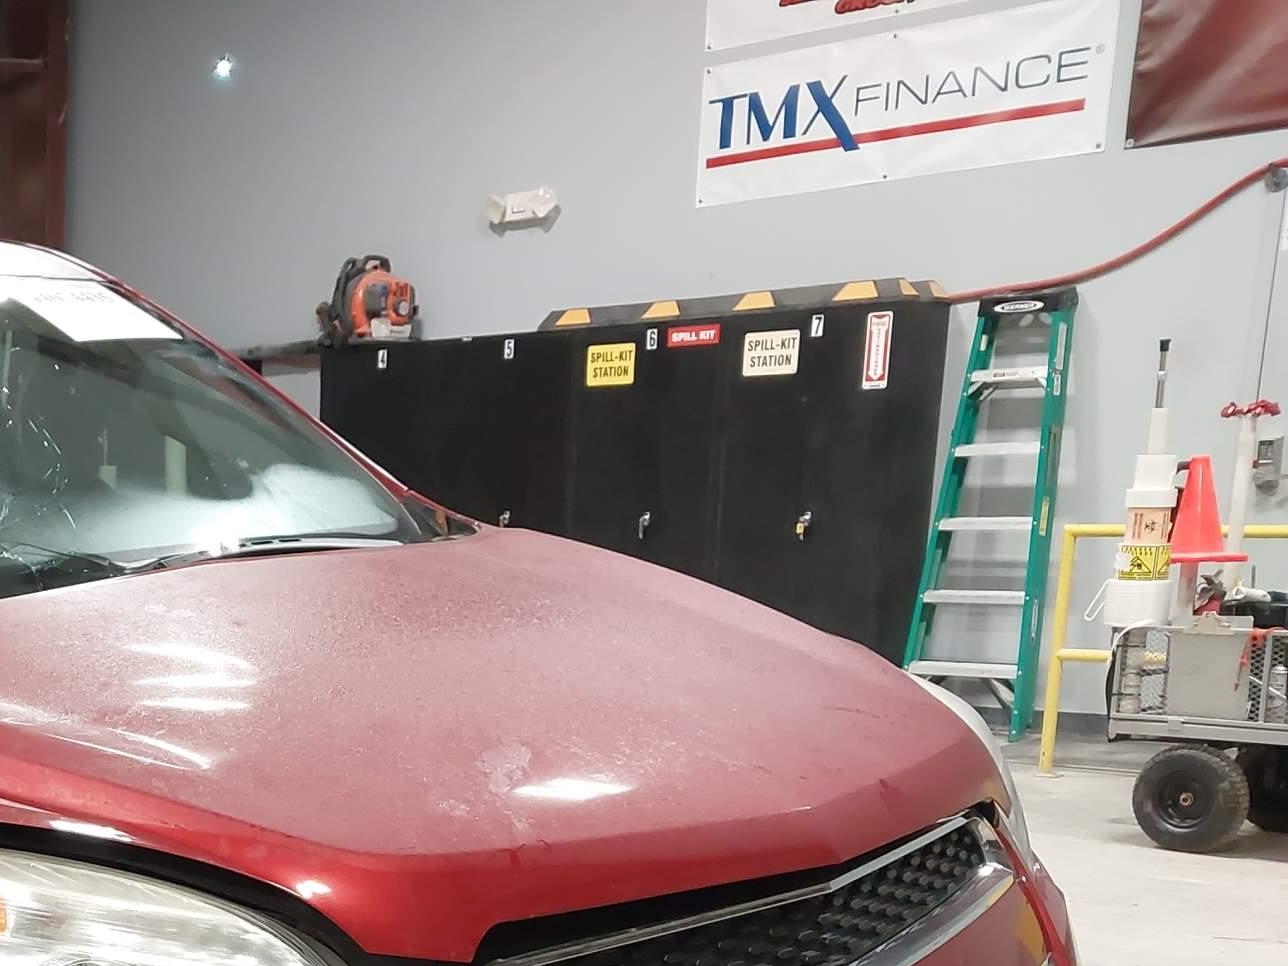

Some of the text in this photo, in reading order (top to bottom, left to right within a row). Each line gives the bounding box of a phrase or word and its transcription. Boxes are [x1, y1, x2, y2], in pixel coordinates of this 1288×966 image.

[708, 46, 1091, 152] TMX FINANCE
[813, 316, 823, 335] 7
[648, 330, 657, 348] 6
[671, 329, 717, 342] SPILL KIT
[505, 340, 513, 358] 5
[747, 336, 798, 352] SPILL-KIT
[379, 351, 386, 367] 4
[590, 349, 634, 364] SPILL-KIT
[749, 353, 793, 368] STATION
[592, 365, 630, 378] STATION
